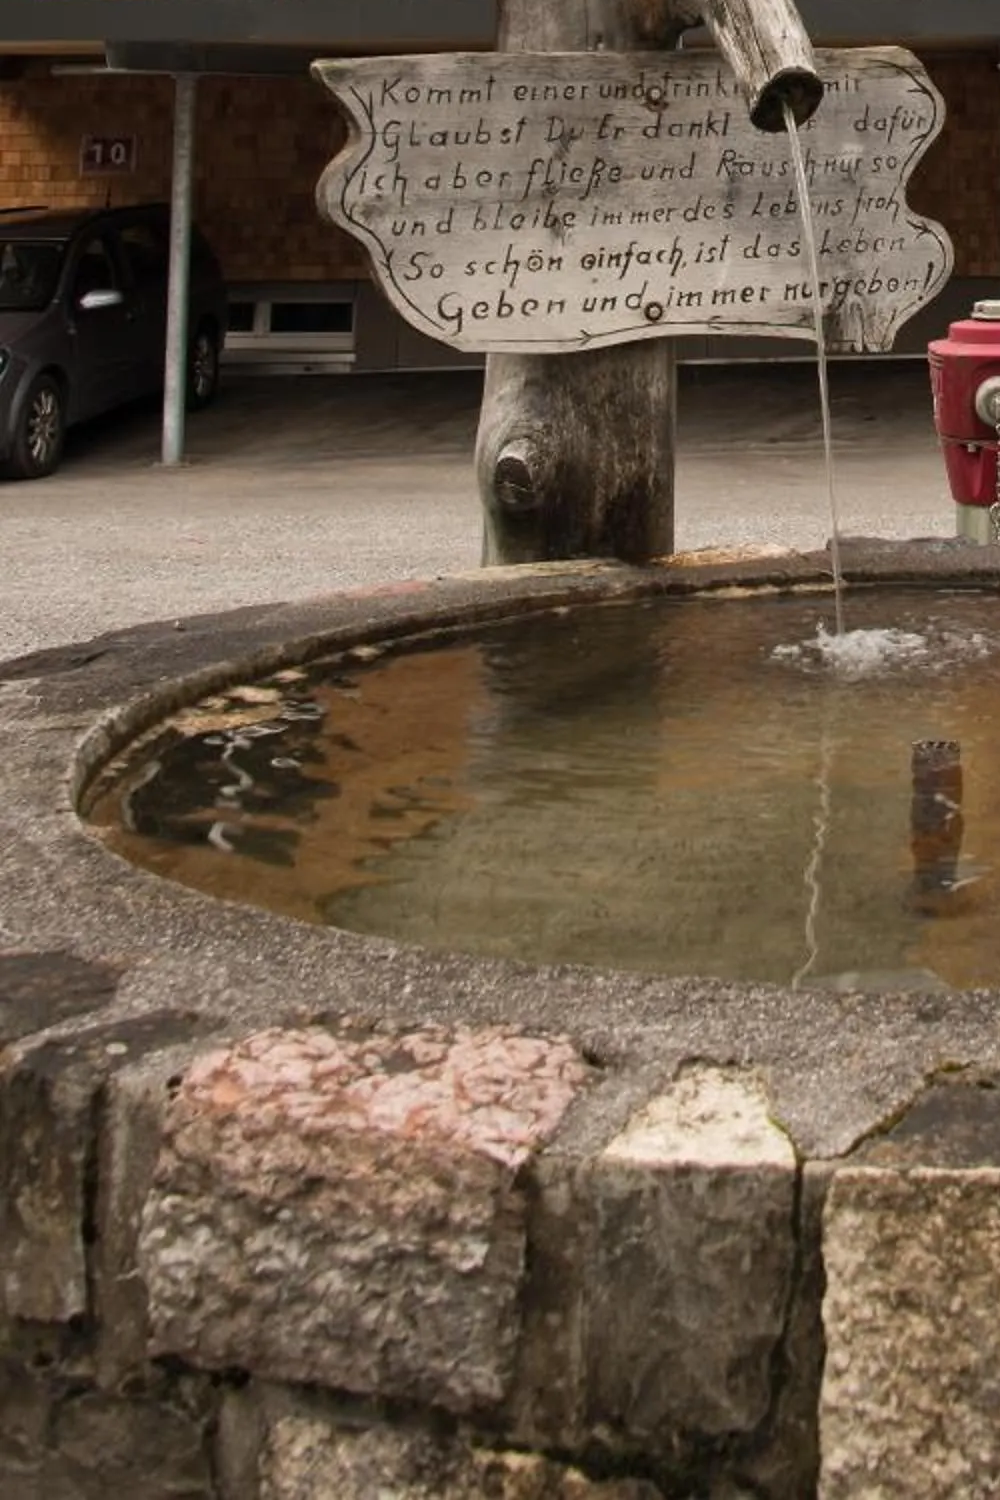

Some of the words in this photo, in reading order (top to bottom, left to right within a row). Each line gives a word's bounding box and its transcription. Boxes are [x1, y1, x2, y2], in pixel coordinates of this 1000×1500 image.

[381, 74, 495, 106] Kommt
[514, 84, 588, 101] einer
[600, 72, 644, 99] und
[92, 143, 126, 164] 10
[382, 116, 526, 163] Glaubst
[854, 104, 927, 143] dafür
[425, 161, 511, 190] aber
[641, 152, 696, 180] und
[716, 148, 816, 187] Raush
[872, 156, 898, 172] so
[392, 207, 453, 236] und
[473, 200, 576, 231] bleibe
[752, 190, 844, 217] Lebns
[404, 252, 444, 280] So
[464, 244, 563, 288] schön
[695, 234, 730, 263] ist
[743, 232, 801, 258] das
[819, 229, 905, 254] Leben
[437, 290, 565, 336] Geben
[583, 281, 648, 312] und
